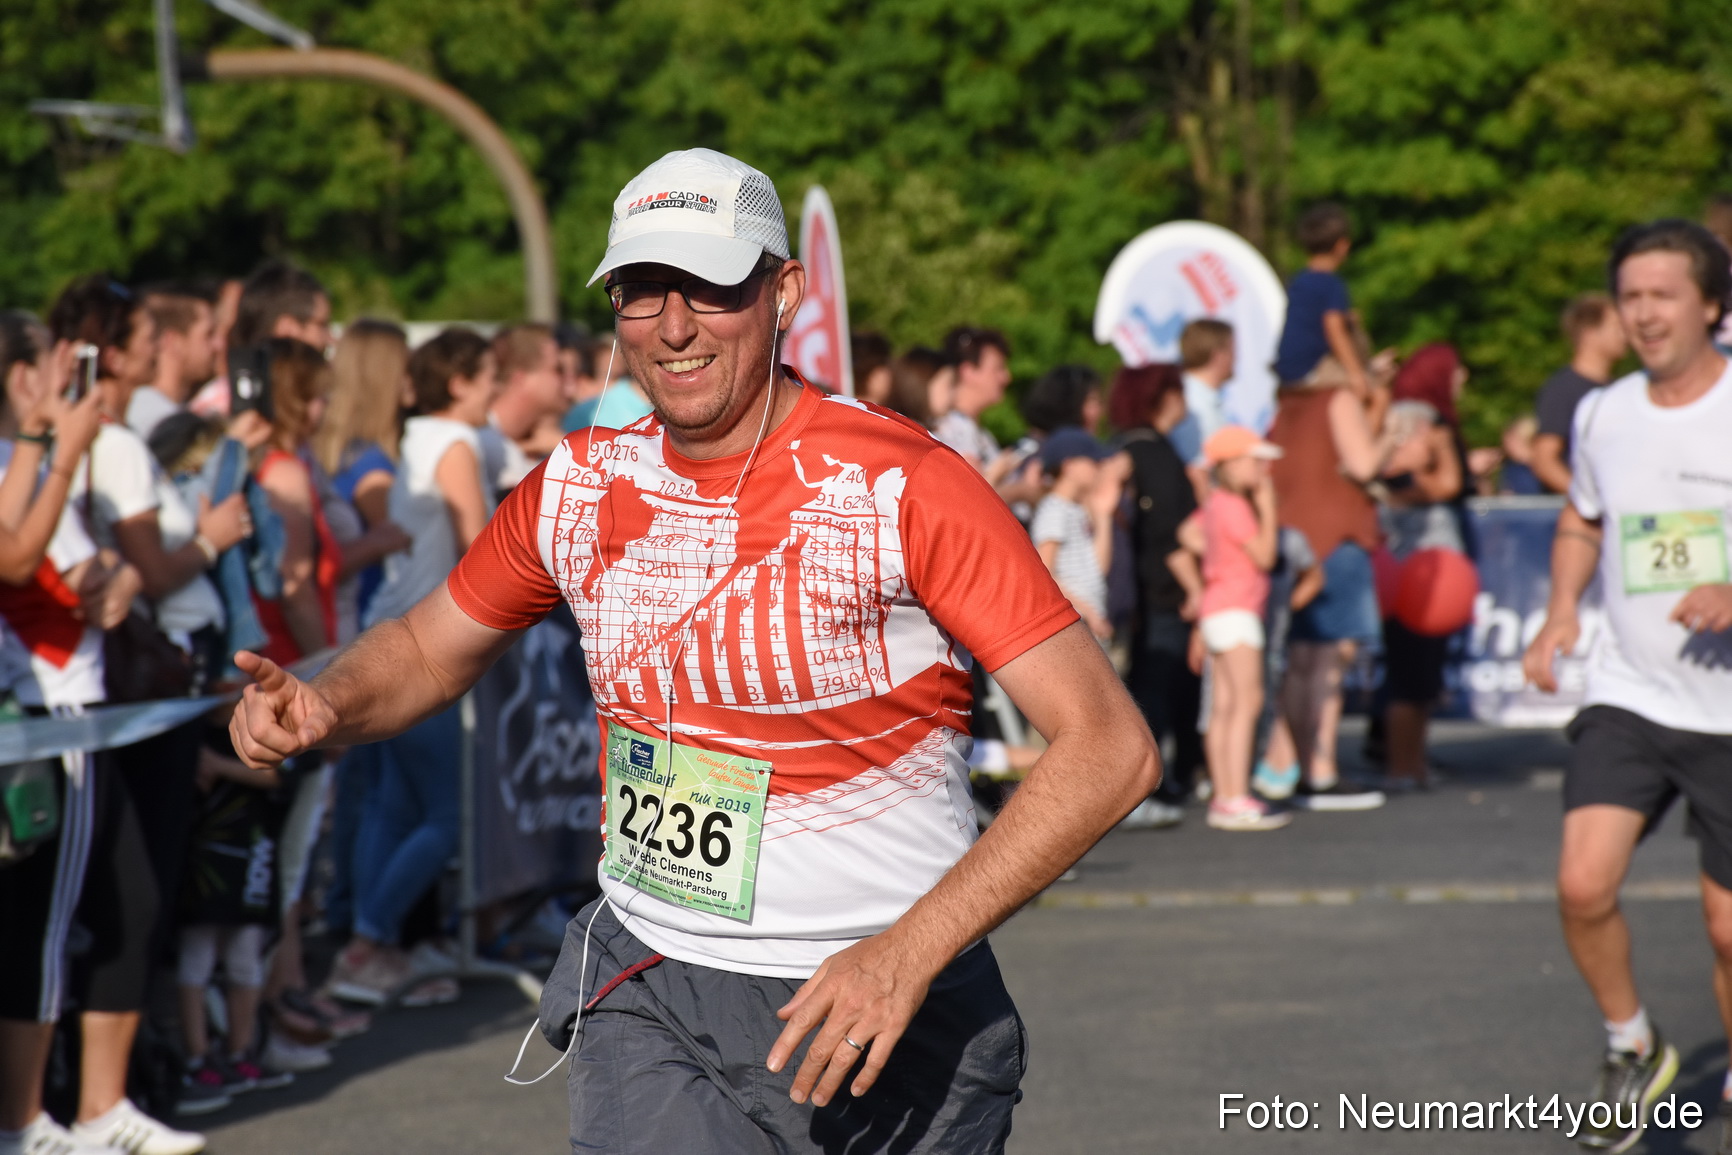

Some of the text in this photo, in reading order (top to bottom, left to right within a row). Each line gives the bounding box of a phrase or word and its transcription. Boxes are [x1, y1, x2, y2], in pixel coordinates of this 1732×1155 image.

[653, 200, 682, 208] YOUR
[685, 201, 717, 214] SPORTS
[656, 480, 693, 498] 10.54
[815, 492, 874, 511] 91.62%
[1651, 537, 1691, 571] 28
[629, 589, 679, 607] 26.22
[697, 754, 729, 771] Gesunde
[708, 768, 732, 784] laufen
[715, 797, 751, 814] 2019
[619, 785, 733, 867] 2236
[619, 854, 649, 876] Sparasse
[649, 868, 728, 900] Neumarkt-Parsberg
[659, 857, 713, 883] Clemens
